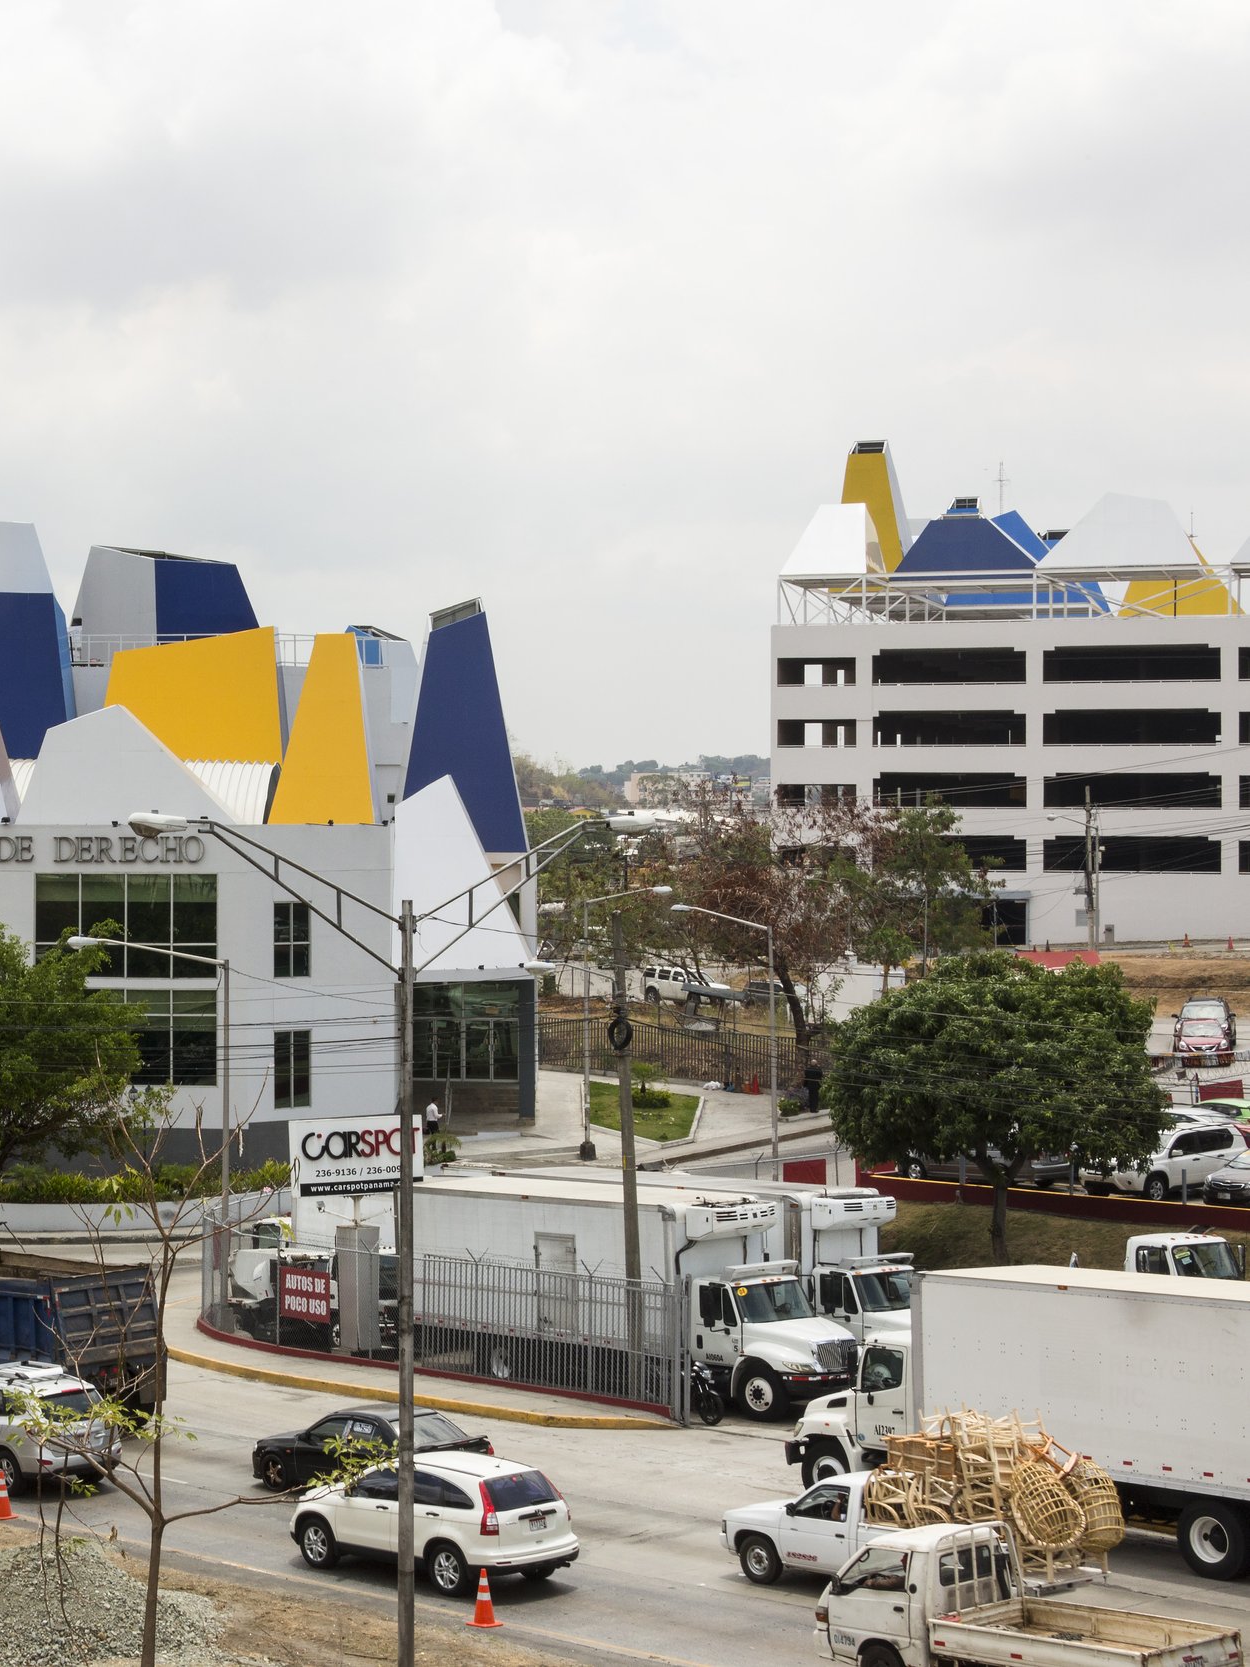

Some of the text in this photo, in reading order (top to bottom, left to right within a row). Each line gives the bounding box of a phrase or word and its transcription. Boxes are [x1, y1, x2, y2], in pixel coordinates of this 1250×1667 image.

[53, 835, 206, 864] DERECHO
[315, 1168, 357, 1178] 236-9136
[366, 1165, 401, 1175] 236-009
[285, 1273, 326, 1294] AUTOS DE
[284, 1294, 327, 1316] POCO USO
